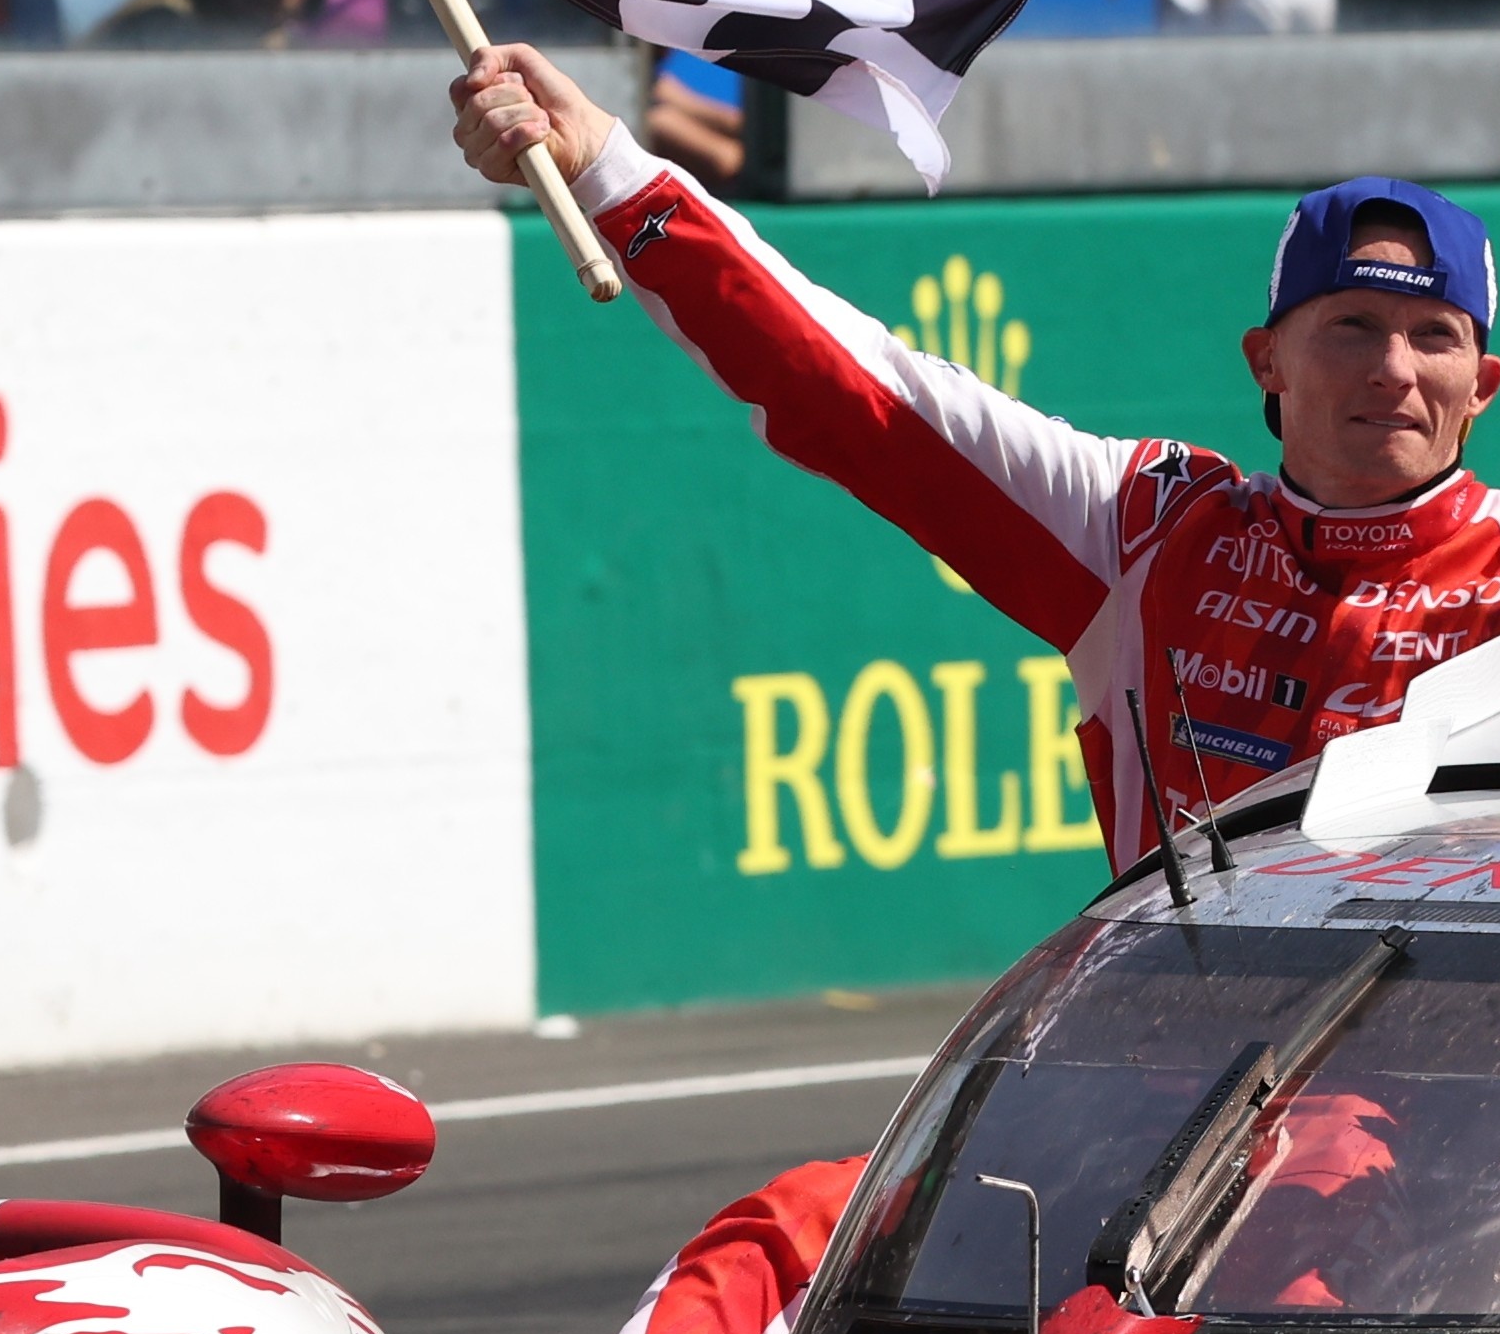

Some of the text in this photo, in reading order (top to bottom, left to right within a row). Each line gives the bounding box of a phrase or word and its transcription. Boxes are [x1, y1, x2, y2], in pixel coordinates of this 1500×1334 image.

[1353, 266, 1435, 288] MICHELIN
[1320, 523, 1414, 543] TOYOTA
[1204, 533, 1320, 596] FUJITSU
[1194, 590, 1319, 644] AISIN
[1369, 628, 1469, 663] ZENT
[1171, 647, 1268, 701] Mobil
[731, 654, 1106, 876] ROLE
[1192, 729, 1279, 763] MICHELIN
